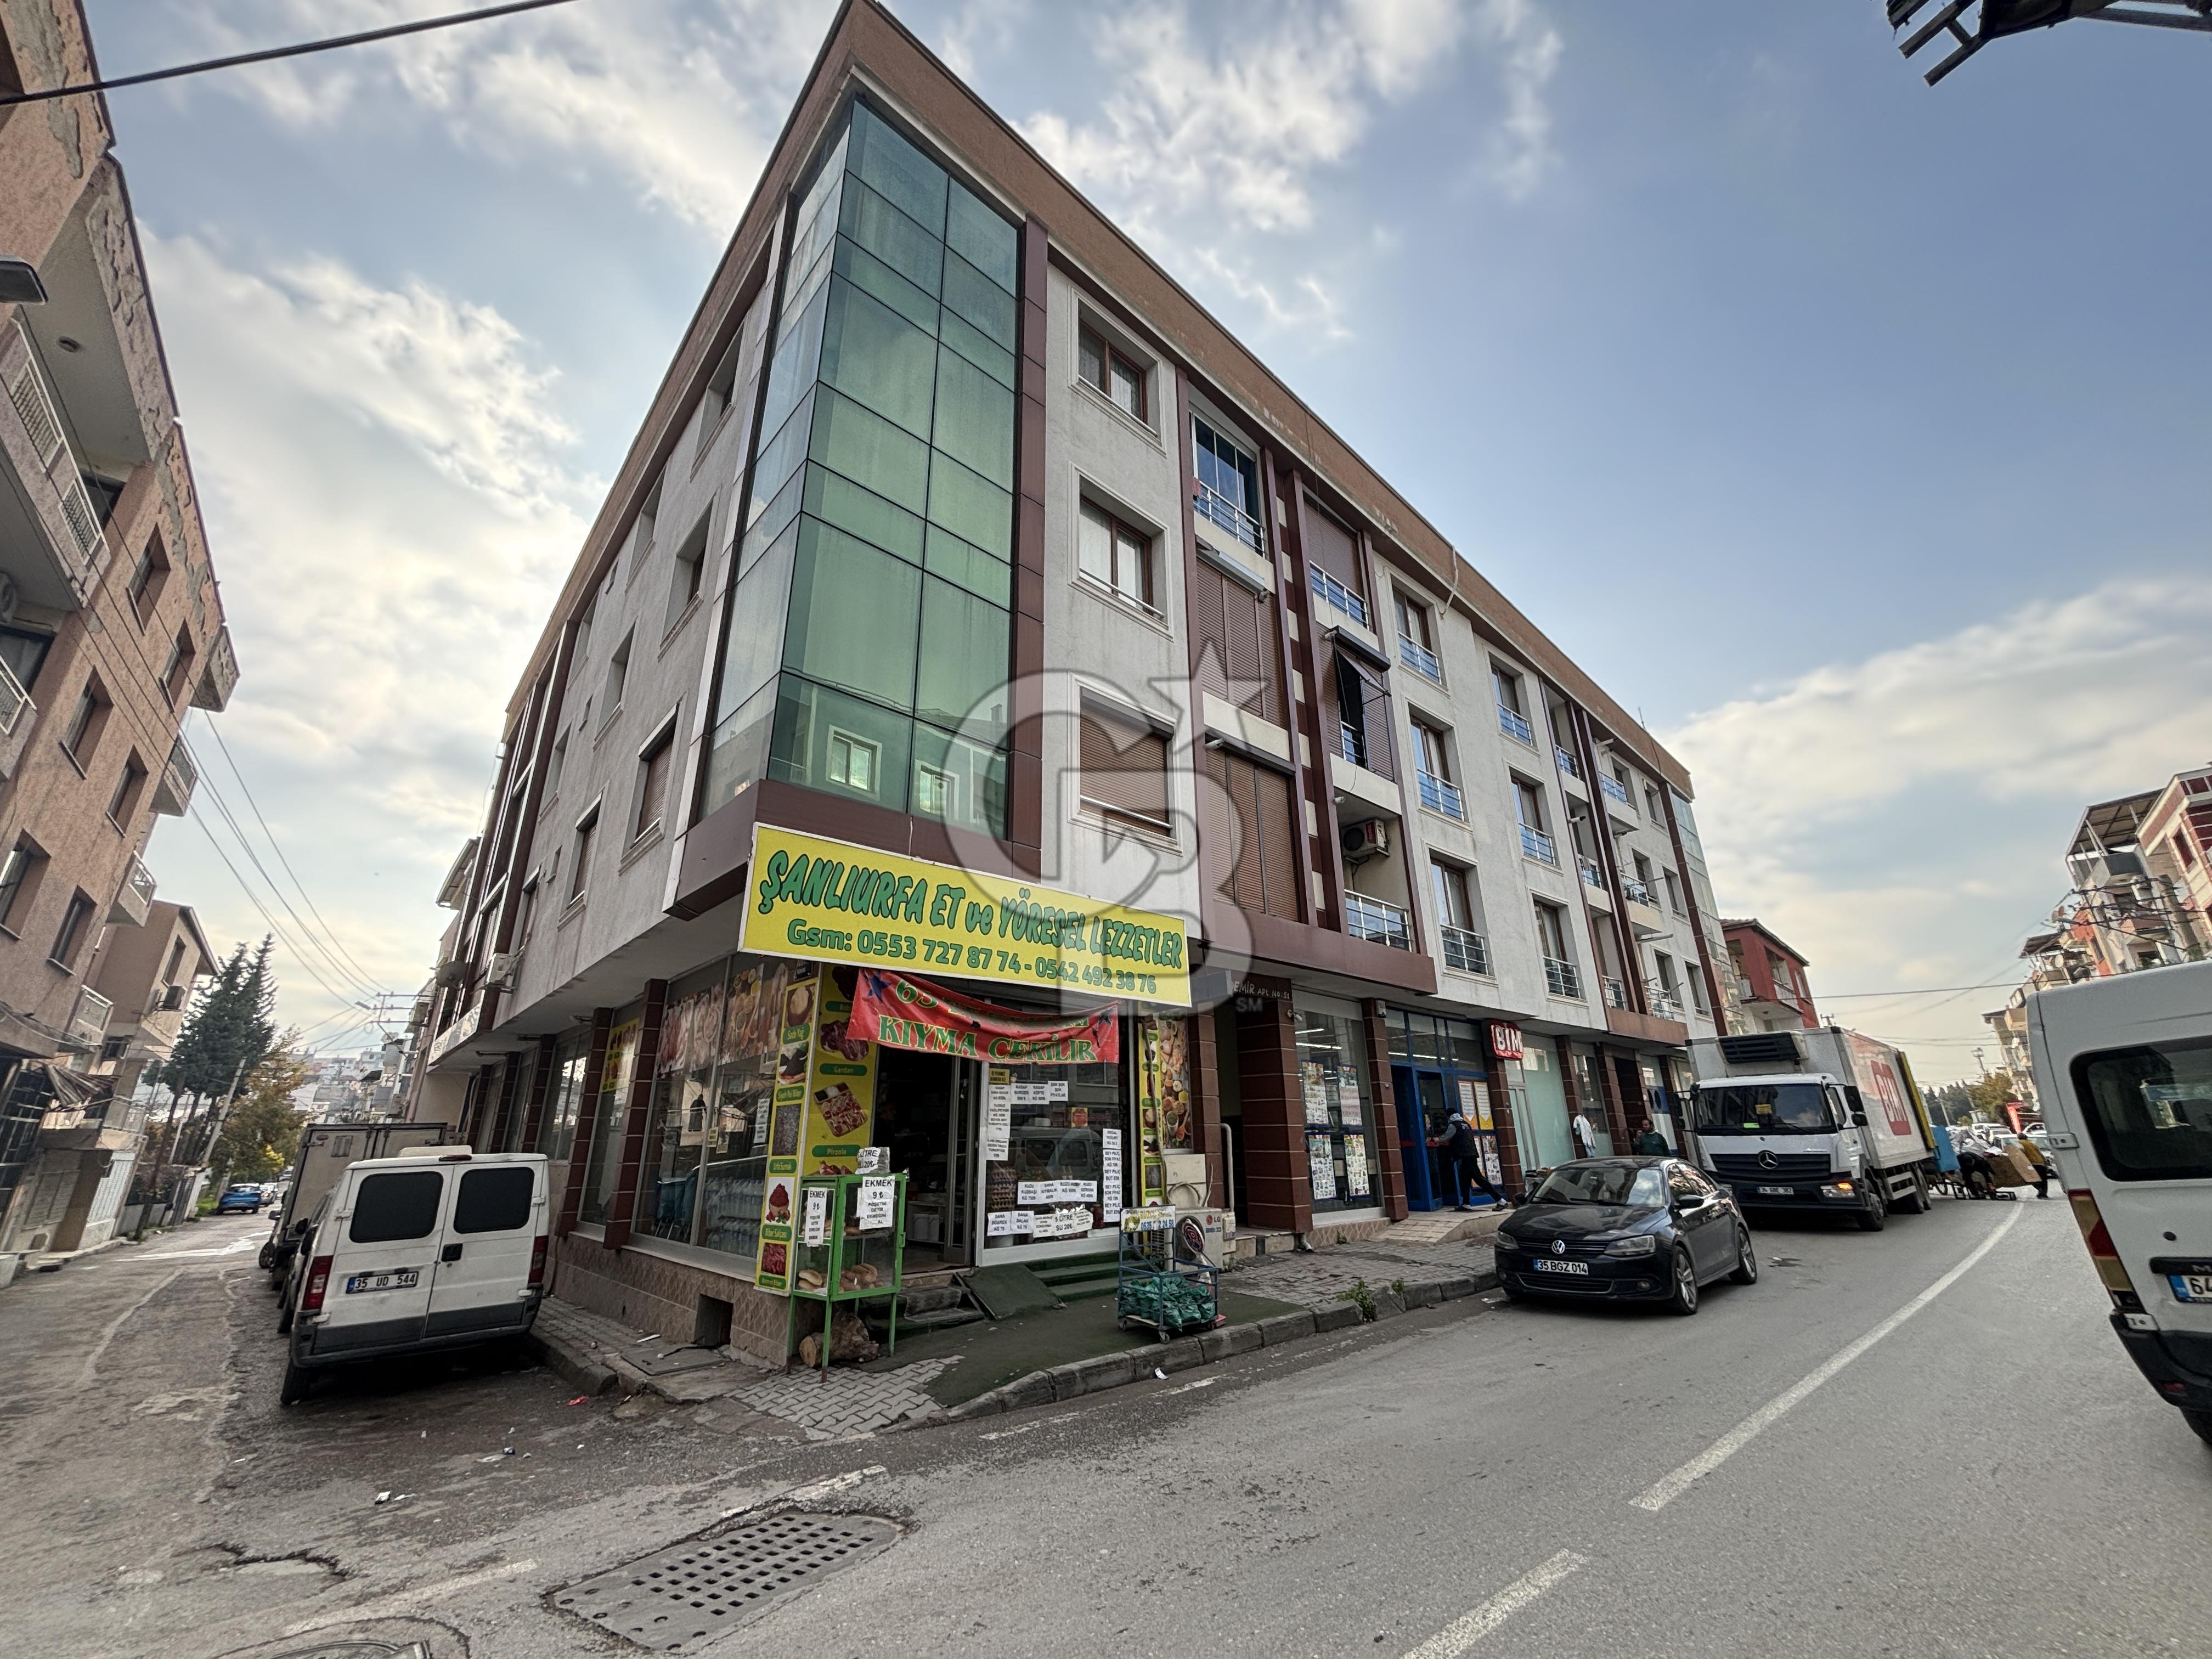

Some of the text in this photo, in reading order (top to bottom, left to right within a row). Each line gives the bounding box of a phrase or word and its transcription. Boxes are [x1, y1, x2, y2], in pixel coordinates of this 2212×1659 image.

[758, 850, 1182, 969] ŞANLIURFA ET ve YÖRESEL LEZZETLER
[787, 919, 853, 951] Gsm:
[857, 929, 917, 960] 0553
[922, 939, 963, 966] 727
[967, 946, 993, 969] 87
[996, 951, 1022, 973] 74
[1036, 957, 1079, 983] 0542
[1082, 965, 1113, 988] 492
[1116, 969, 1136, 991] 38
[1138, 974, 1157, 994] 76
[878, 1014, 1098, 1063] KIYMA ÇEKİLİR
[355, 1278, 369, 1289] 35
[397, 1274, 415, 1284] 544
[1538, 1260, 1587, 1274] 35 BGZ 014
